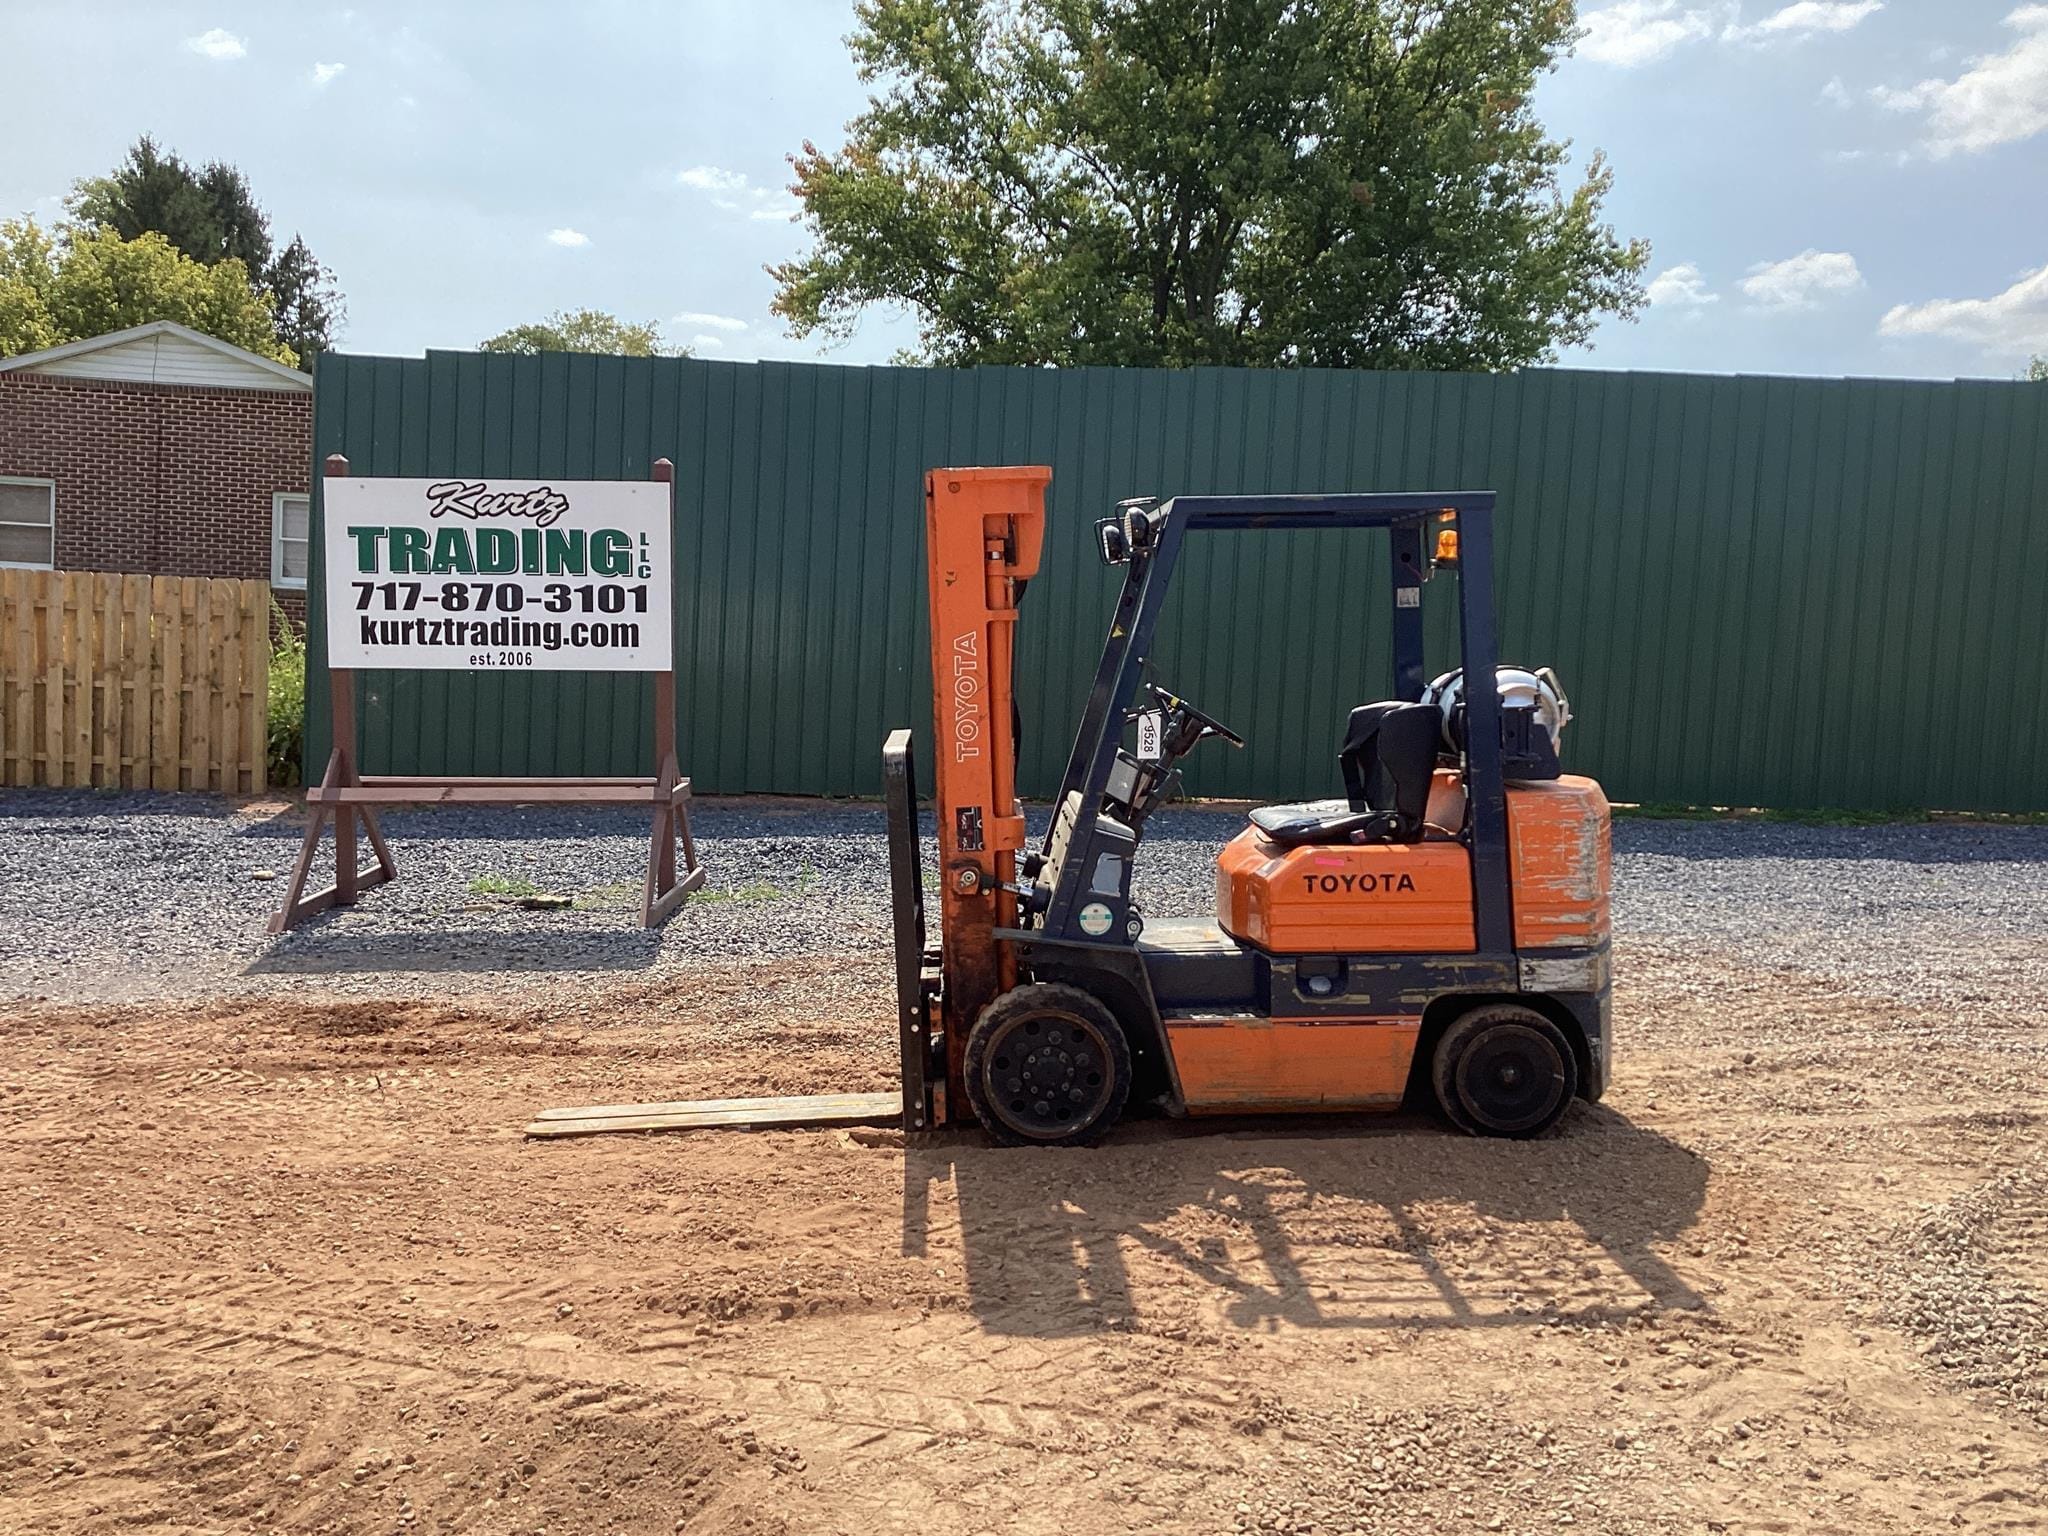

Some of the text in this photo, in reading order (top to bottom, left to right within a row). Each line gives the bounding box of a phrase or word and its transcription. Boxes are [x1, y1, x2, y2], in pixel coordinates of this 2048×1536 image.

[426, 481, 569, 527] Kurtz
[347, 526, 652, 579] TRADING LLC
[351, 582, 648, 613] 717-870-3101
[360, 616, 640, 650] kurtztrading.com
[470, 652, 533, 666] est. 2006
[953, 631, 980, 763] TOYOTA
[1143, 725, 1154, 753] 9528
[1303, 873, 1416, 893] TOYOTA
